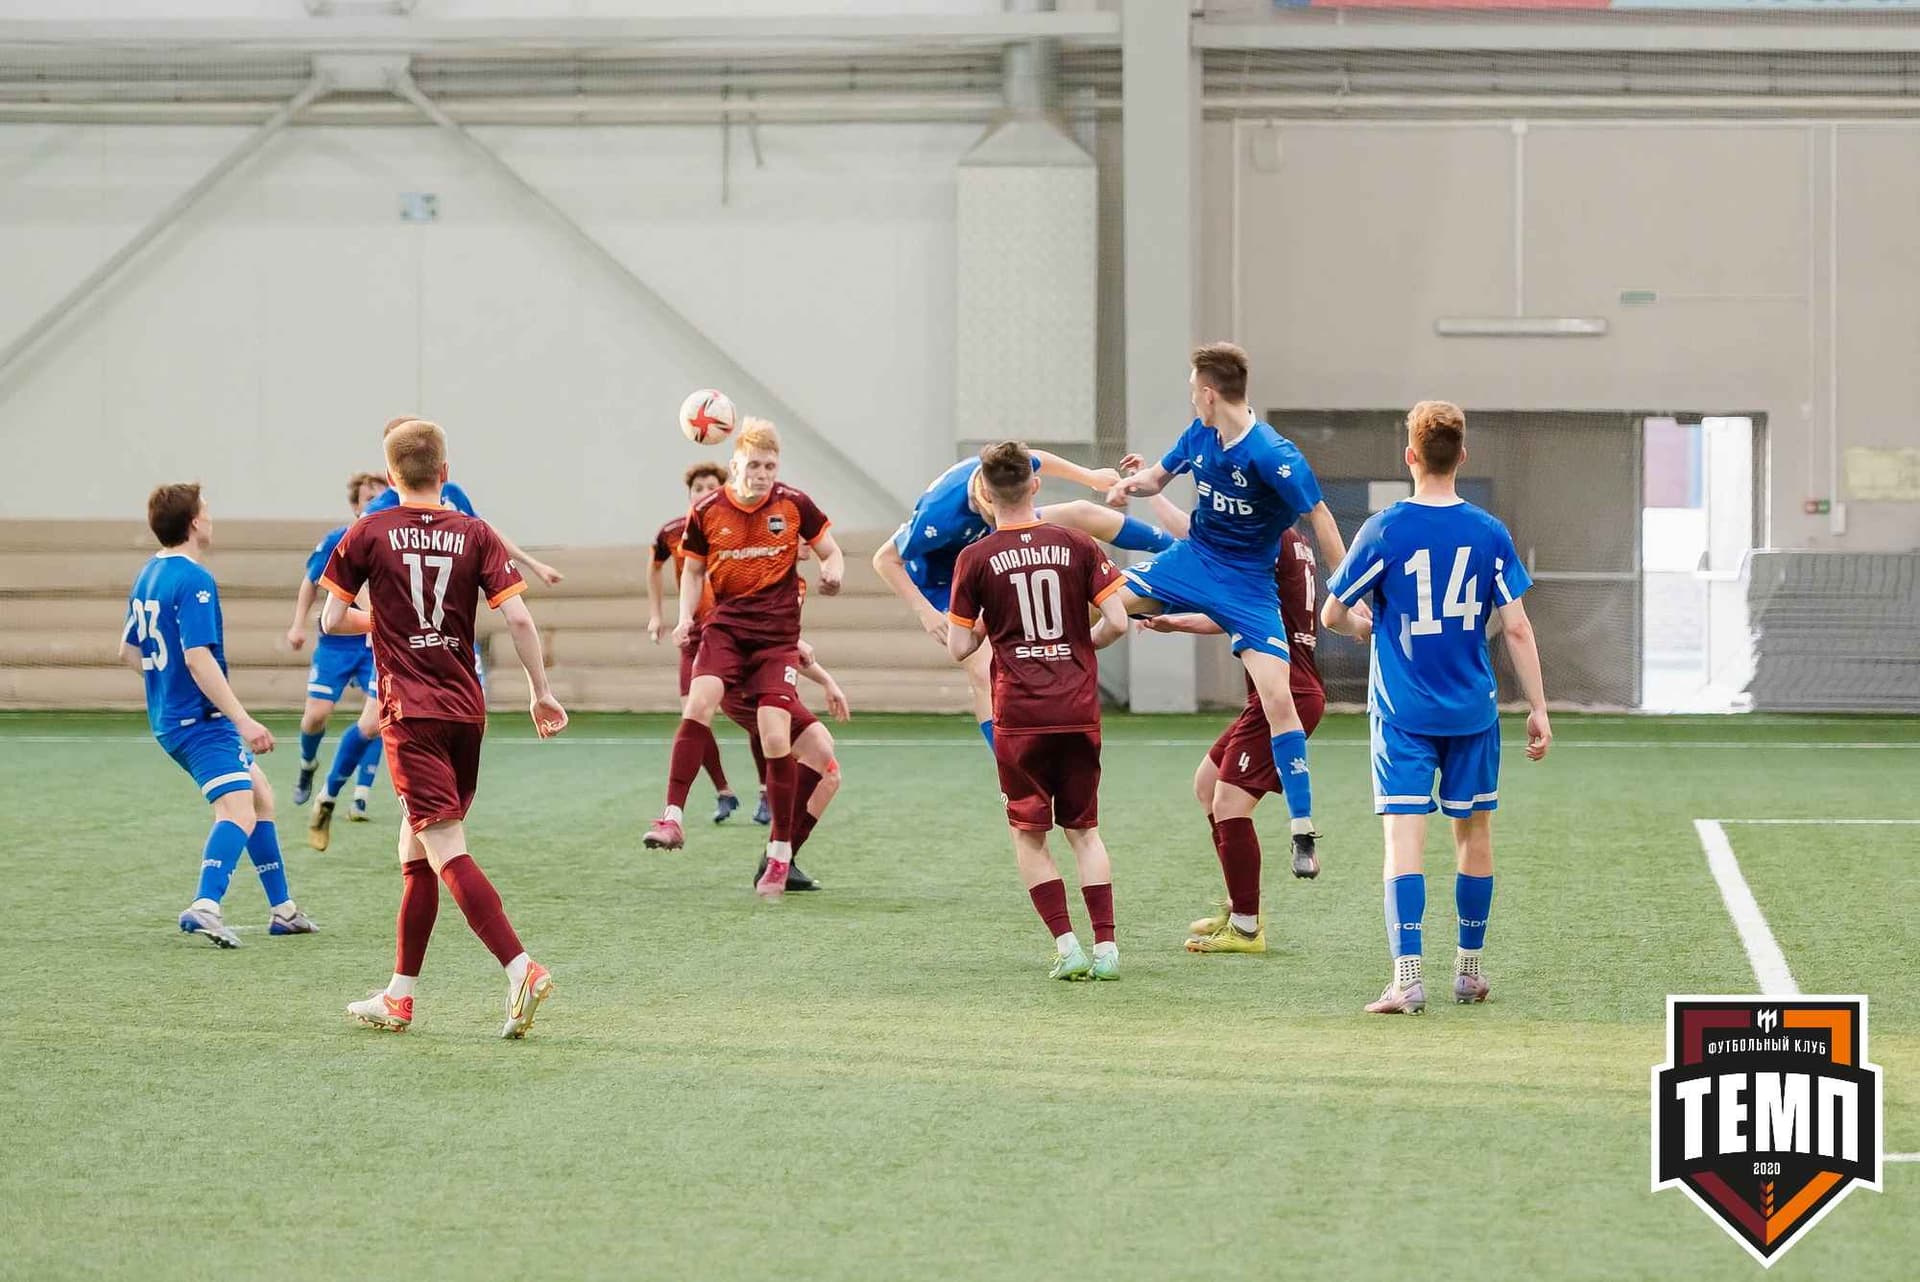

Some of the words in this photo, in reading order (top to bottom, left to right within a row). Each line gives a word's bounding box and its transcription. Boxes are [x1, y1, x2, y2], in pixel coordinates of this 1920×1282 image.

[1212, 491, 1254, 516] ВТБ
[388, 527, 466, 554] КУЗЬКИН
[990, 545, 1070, 575] АПАЛЬКИН
[402, 553, 453, 631] 17
[1403, 546, 1482, 635] 14
[1009, 569, 1064, 641] 10
[1015, 644, 1071, 659] SEUS
[1238, 751, 1251, 773] 4
